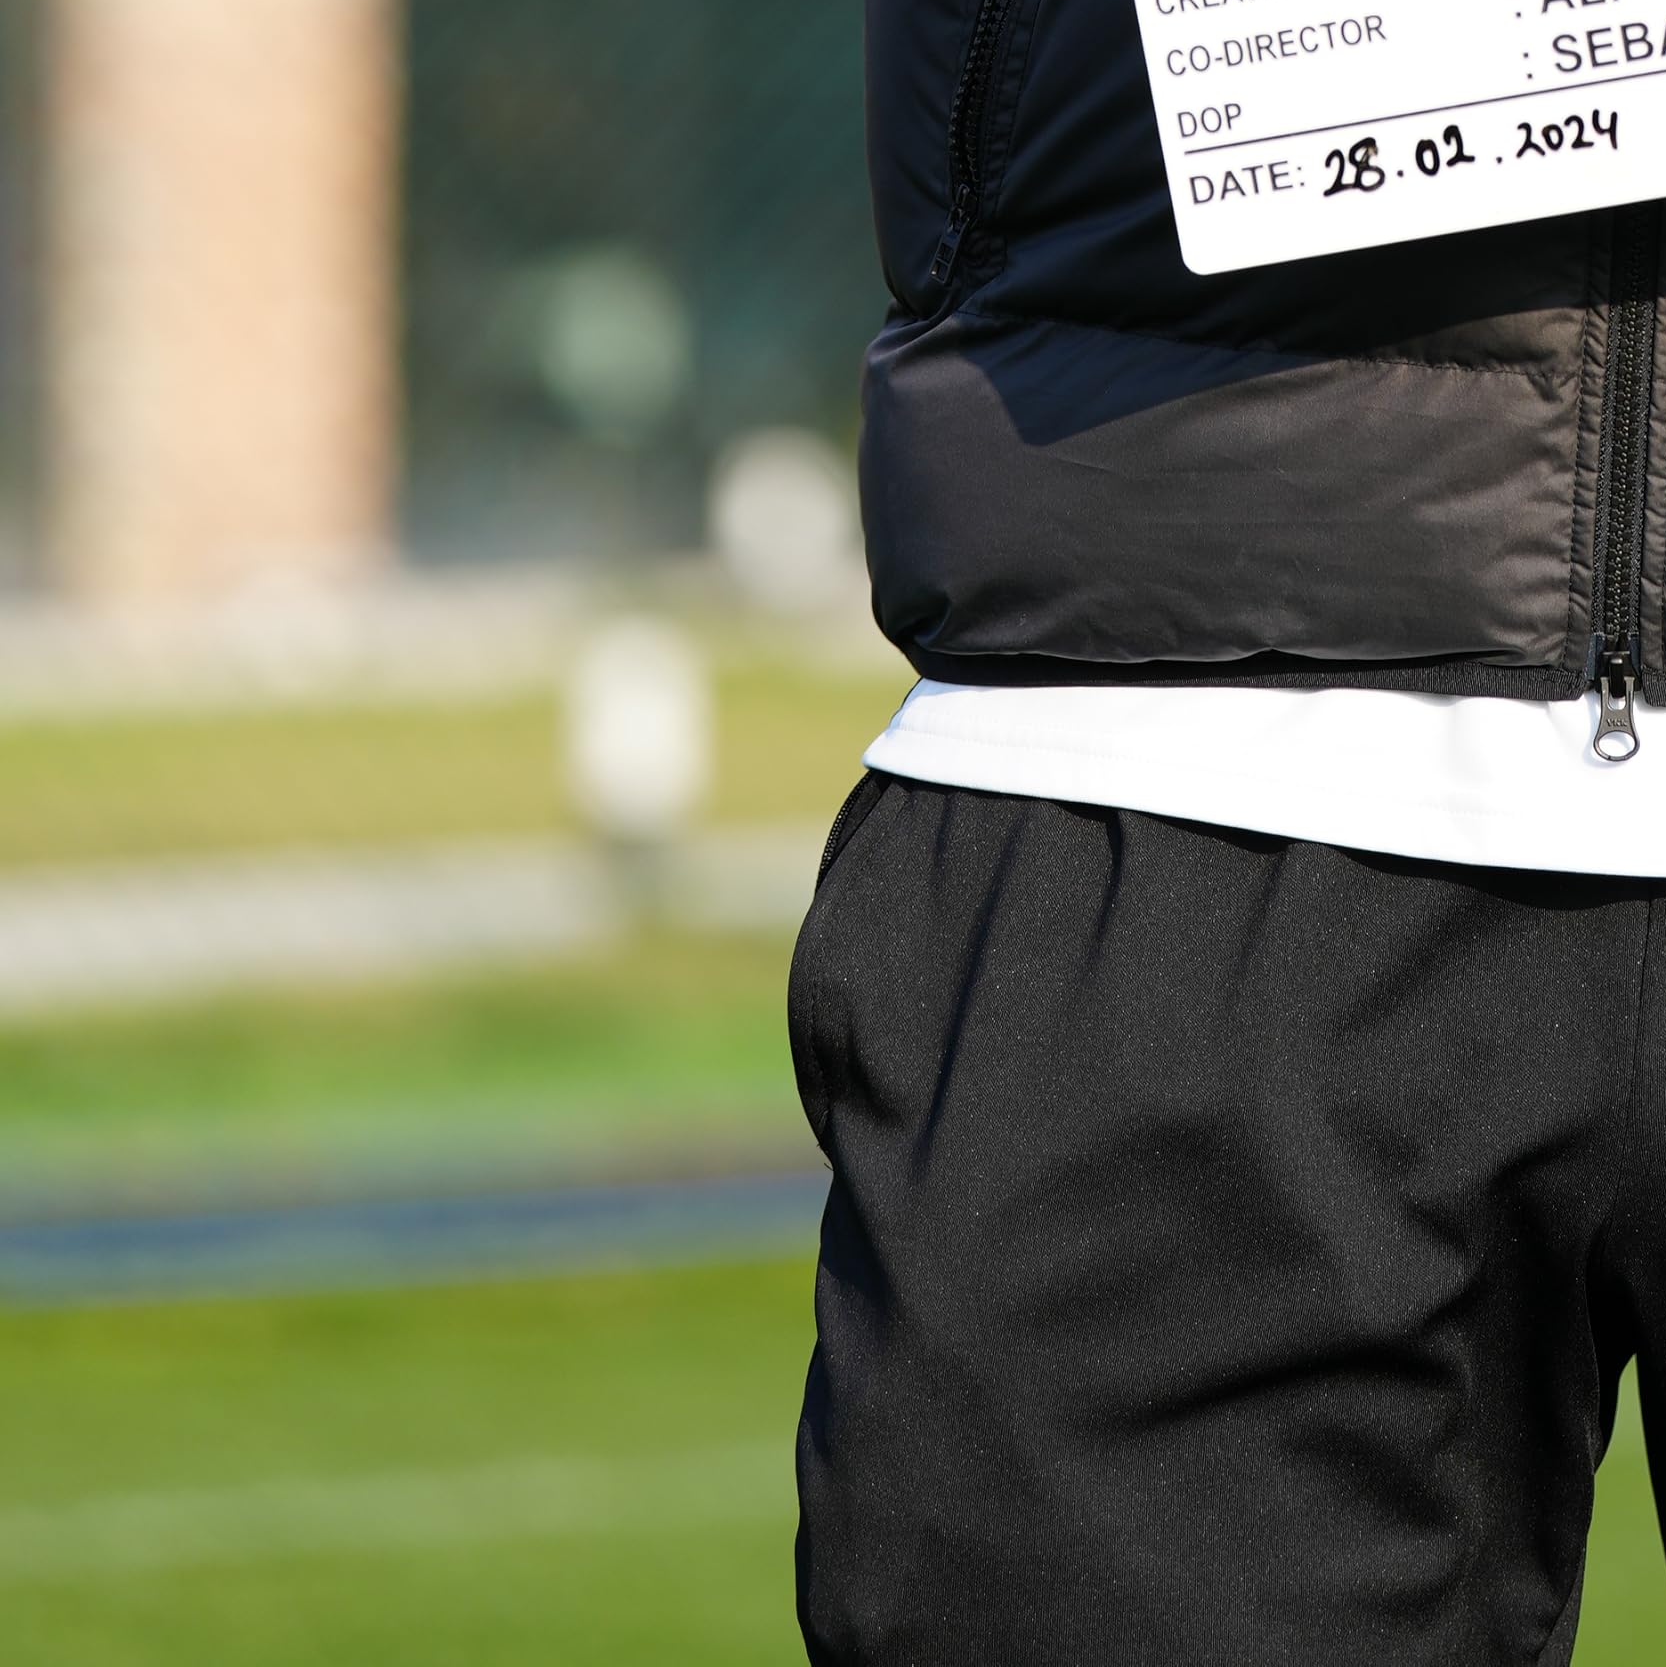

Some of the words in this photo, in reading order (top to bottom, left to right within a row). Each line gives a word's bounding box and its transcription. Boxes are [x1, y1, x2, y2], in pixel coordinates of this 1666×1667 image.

[1166, 14, 1387, 77] CO-DIRECTOR
[1177, 103, 1242, 139] DOP
[1189, 160, 1305, 205] DATE:
